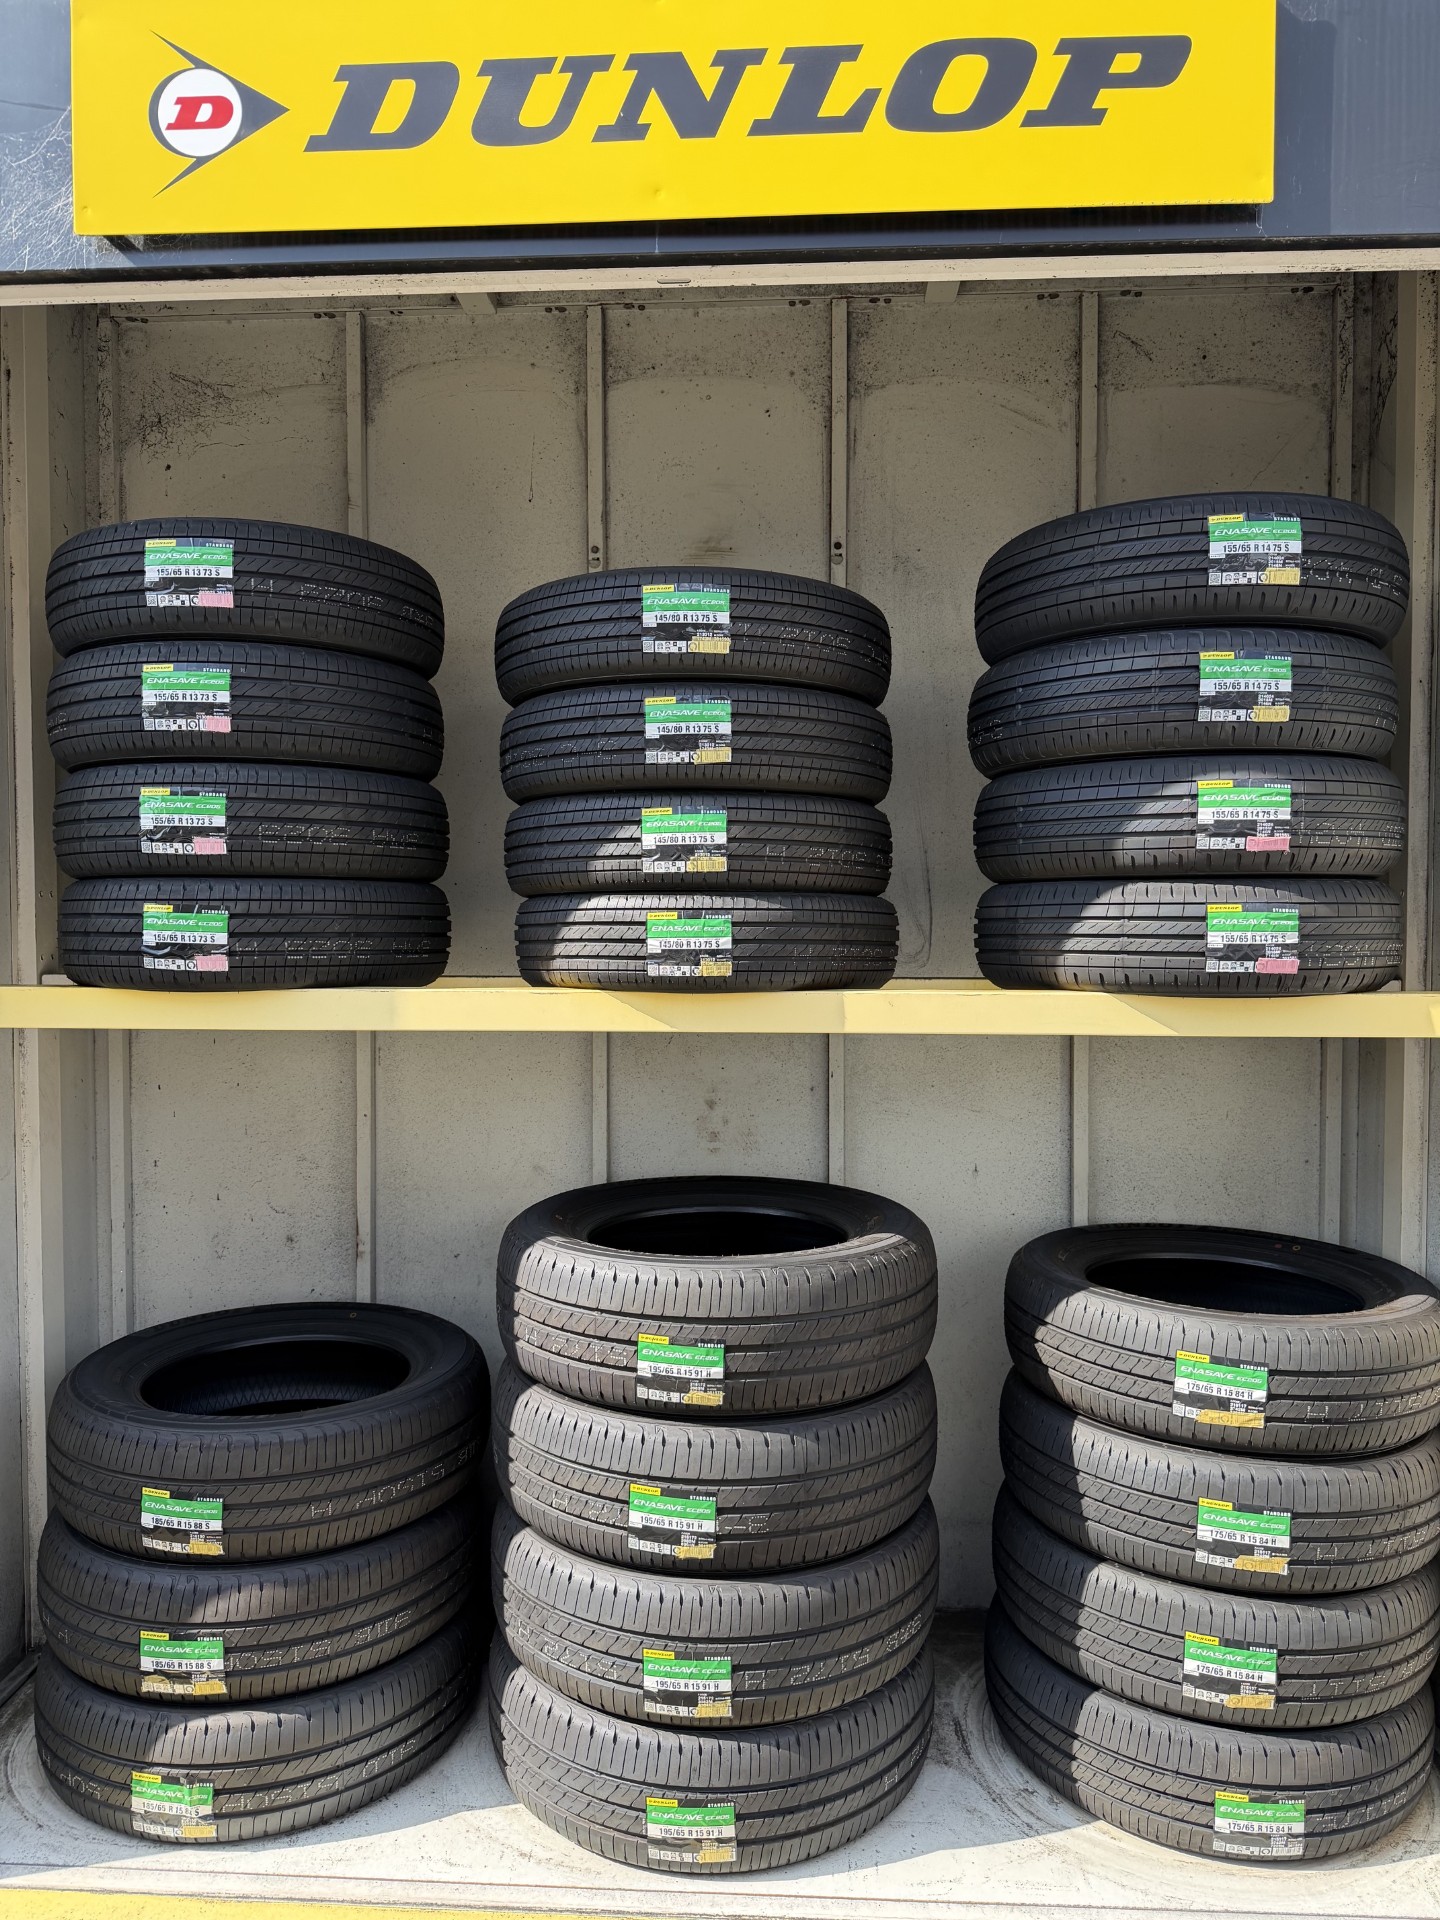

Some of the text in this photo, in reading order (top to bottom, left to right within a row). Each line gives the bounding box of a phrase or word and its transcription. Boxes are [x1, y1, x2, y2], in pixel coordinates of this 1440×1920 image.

[166, 35, 1192, 152] D DUNLOP
[1215, 528, 1271, 536] ENASAVE
[1223, 543, 1290, 552] 155/65 R 14 75 S
[149, 552, 200, 560] ENASAVE
[157, 568, 220, 576] 155/65 R 13 73 S
[654, 614, 718, 622] 145/80 R 13 75 S
[1213, 682, 1279, 690] 155/65 R 14 75 S
[714, 725, 719, 733] S
[654, 836, 679, 844] 145/80
[1220, 934, 1286, 942] 155/65 R 14 75 S
[659, 940, 720, 948] 145/80 R 13 75 S
[642, 1349, 694, 1359] ENASAVE
[649, 1365, 674, 1375] 195/65
[684, 1368, 693, 1376] 15
[695, 1369, 703, 1377] 91
[706, 1370, 711, 1378] H
[1181, 1365, 1235, 1379] ENASAVE
[1224, 1388, 1233, 1396] 15
[1235, 1390, 1245, 1398] 84
[1247, 1391, 1253, 1399] H
[145, 1502, 193, 1512] ENASAVE
[634, 1499, 686, 1511] ENASAVE
[151, 1517, 175, 1526] 185/65
[194, 1521, 203, 1529] 88
[205, 1522, 210, 1530] S
[640, 1516, 702, 1530] 195/65 R 15 91 H
[1202, 1513, 1259, 1525] ENASAVE
[1210, 1530, 1277, 1545] 175/65 R 15 84 H
[144, 1645, 193, 1654] ENASAVE
[1190, 1648, 1245, 1662] ENASAVE
[151, 1660, 175, 1668] 185/65
[195, 1662, 205, 1670] 88
[648, 1663, 700, 1673] ENASAVE
[1196, 1665, 1263, 1682] 175/65 R 15 84 H
[655, 1680, 681, 1688] 195/65
[684, 1682, 689, 1690] R
[691, 1682, 700, 1690] 15
[702, 1682, 711, 1690] 91
[142, 1802, 166, 1811] 185/65
[176, 1806, 184, 1814] 15
[195, 1808, 200, 1816] S
[1220, 1805, 1274, 1816] ENASAVE
[651, 1812, 704, 1821] ENASAVE
[659, 1828, 686, 1836] 195/65
[1228, 1822, 1254, 1831] 175/65
[1265, 1824, 1274, 1832] 15
[1275, 1825, 1285, 1833] 84
[1288, 1825, 1292, 1833] H
